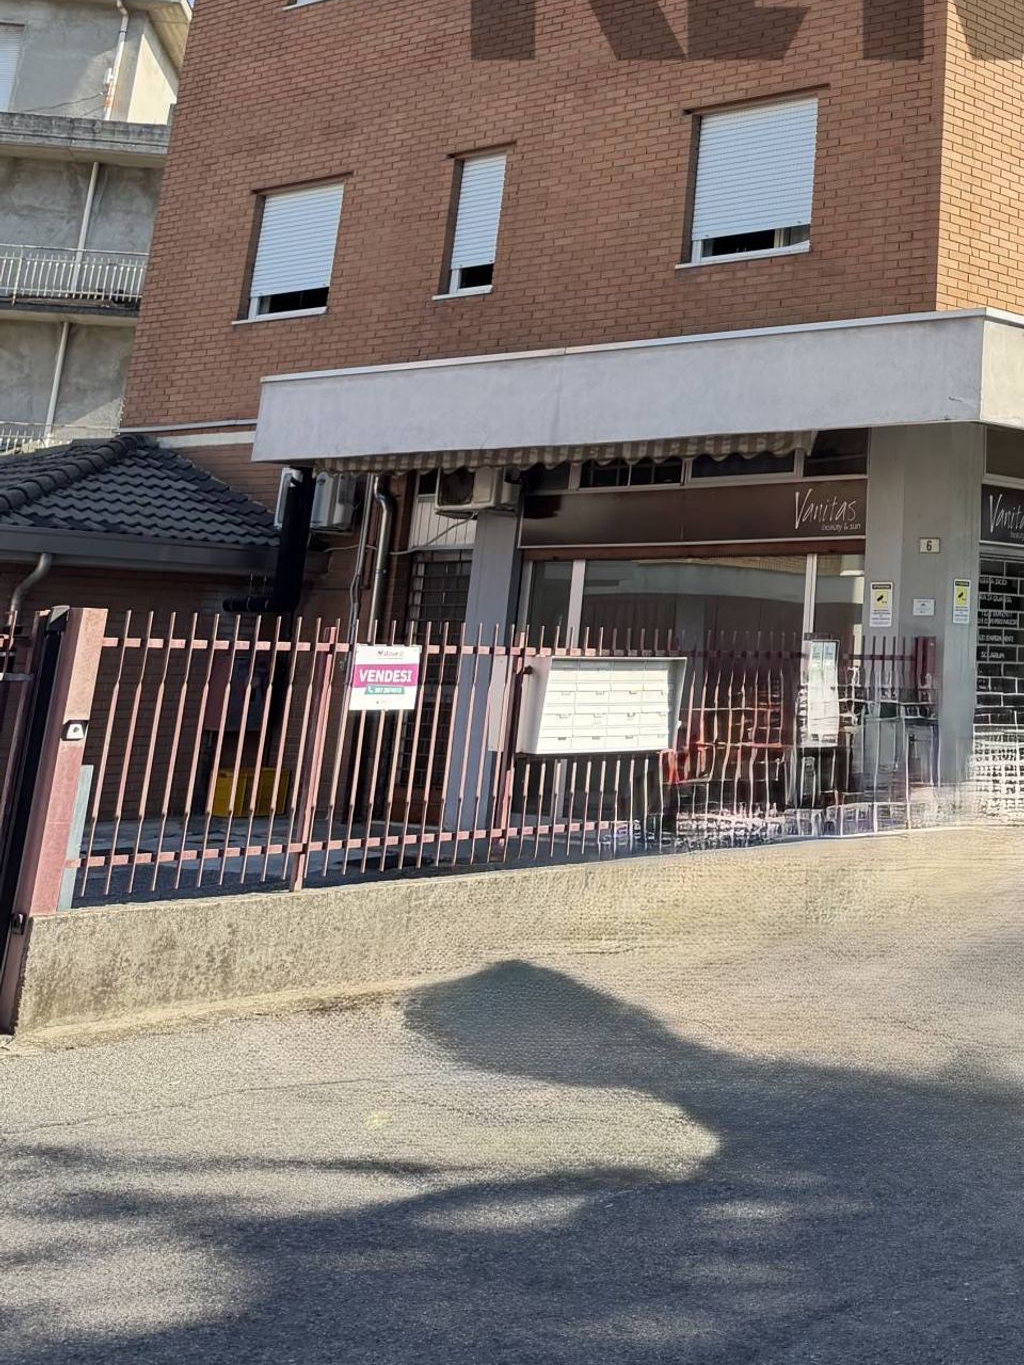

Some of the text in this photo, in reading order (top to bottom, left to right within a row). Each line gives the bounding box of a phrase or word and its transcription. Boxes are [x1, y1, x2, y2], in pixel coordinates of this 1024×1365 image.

[795, 488, 857, 530] Vanitas
[926, 540, 932, 551] 6
[359, 669, 412, 682] VENDESI
